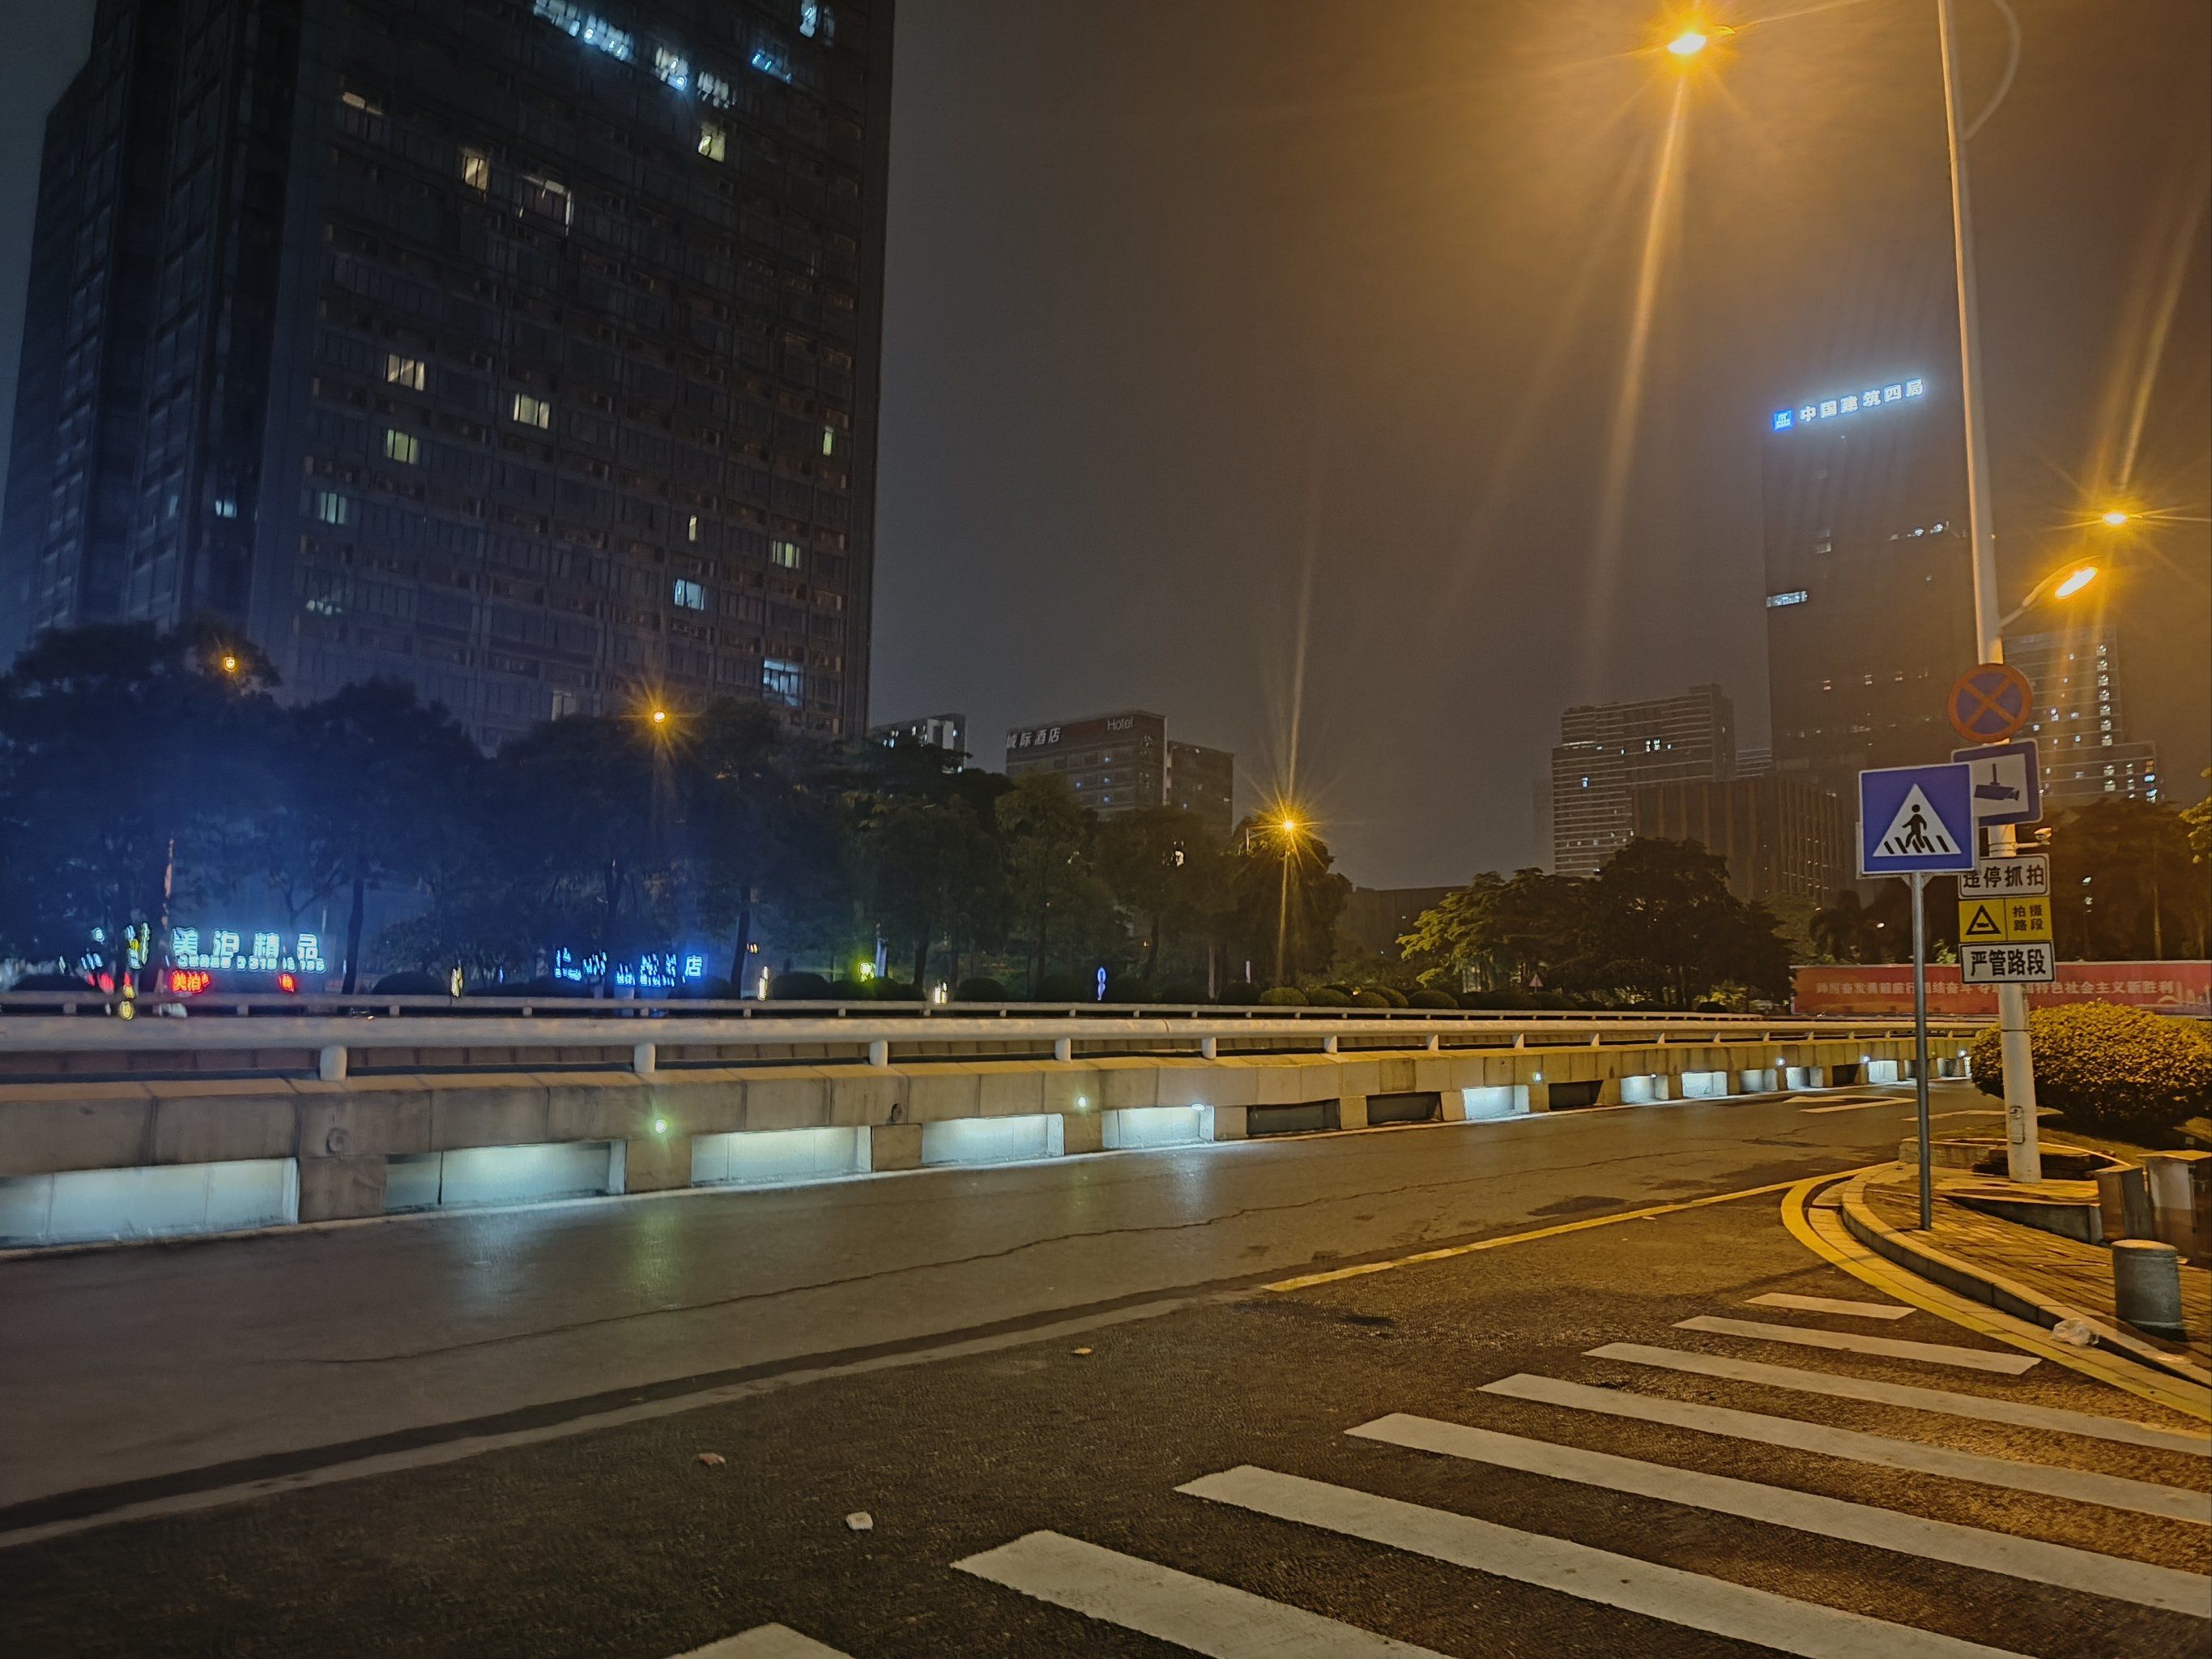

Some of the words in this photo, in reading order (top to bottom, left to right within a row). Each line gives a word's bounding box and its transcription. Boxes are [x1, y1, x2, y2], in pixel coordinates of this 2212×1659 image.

[1800, 378, 1924, 422] 中国建筑四局
[1107, 716, 1134, 731] Hotel
[1963, 864, 2044, 889] 违停抓拍
[2014, 918, 2044, 932] 路段
[1971, 949, 2047, 977] 严管路段
